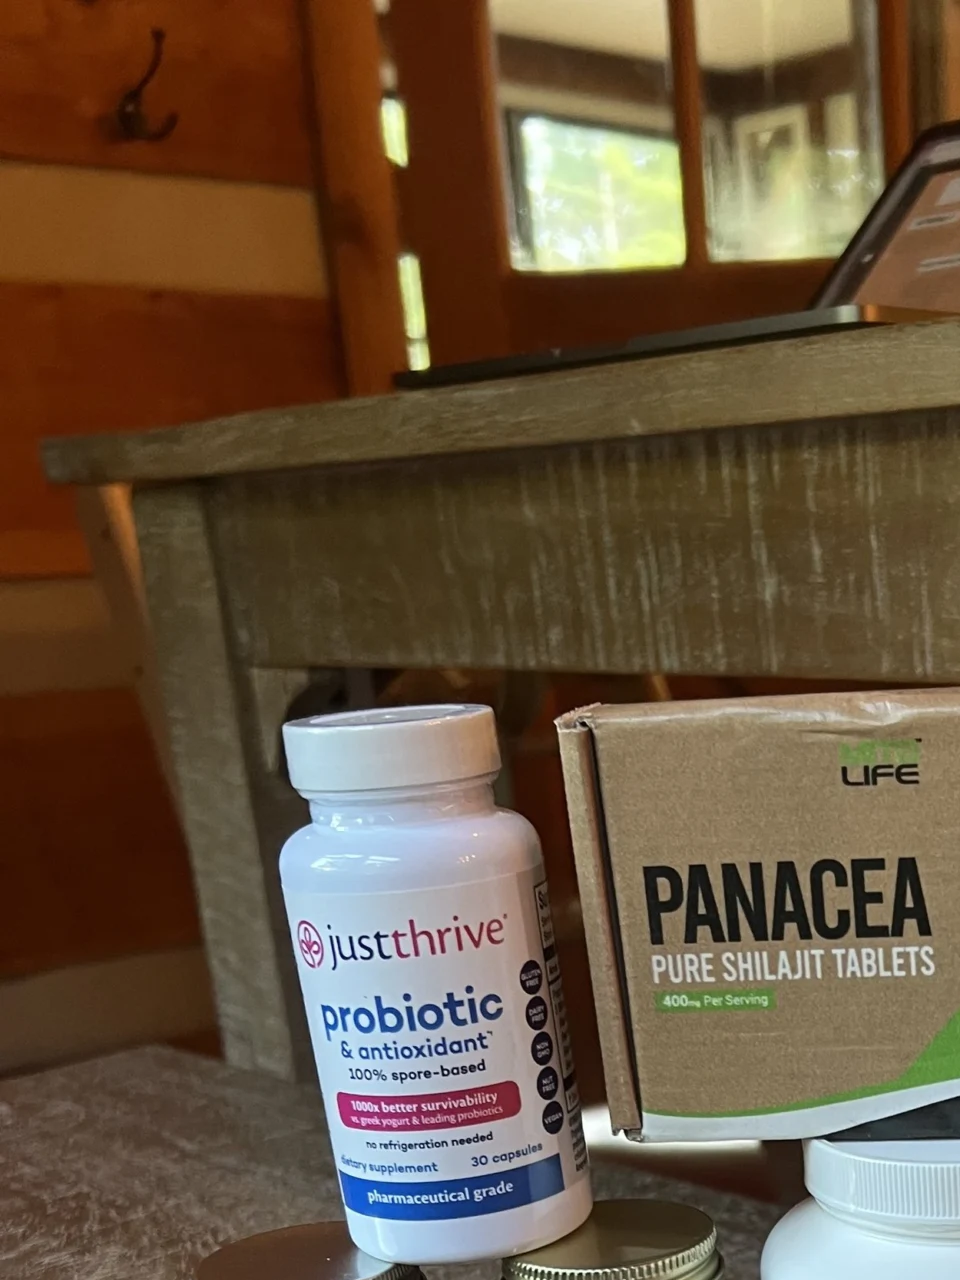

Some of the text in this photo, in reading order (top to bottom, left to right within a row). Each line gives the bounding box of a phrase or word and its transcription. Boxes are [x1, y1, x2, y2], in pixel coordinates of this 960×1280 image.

[841, 763, 920, 787] LIFE
[643, 857, 932, 945] PANACEA
[327, 915, 505, 970] justthrive
[652, 945, 936, 984] PURE SHILAJIT TABLETS
[525, 977, 539, 988] FREE
[703, 995, 723, 1007] Per
[724, 993, 769, 1007] Serving
[320, 985, 504, 1041] probiotic
[531, 1013, 545, 1024] FREE
[340, 1031, 489, 1061] & antioxidant
[348, 1059, 487, 1084] 100% spore-based
[350, 1092, 499, 1114] 1000x better survivability
[360, 1105, 504, 1129] greek yogurt & leading probiotics
[544, 1111, 563, 1126] VEGAN
[366, 1131, 494, 1152] no refrigeration needed
[341, 1142, 544, 1177] dietary supplement 30 capsules
[366, 1180, 514, 1205] pharmaceutical grade
